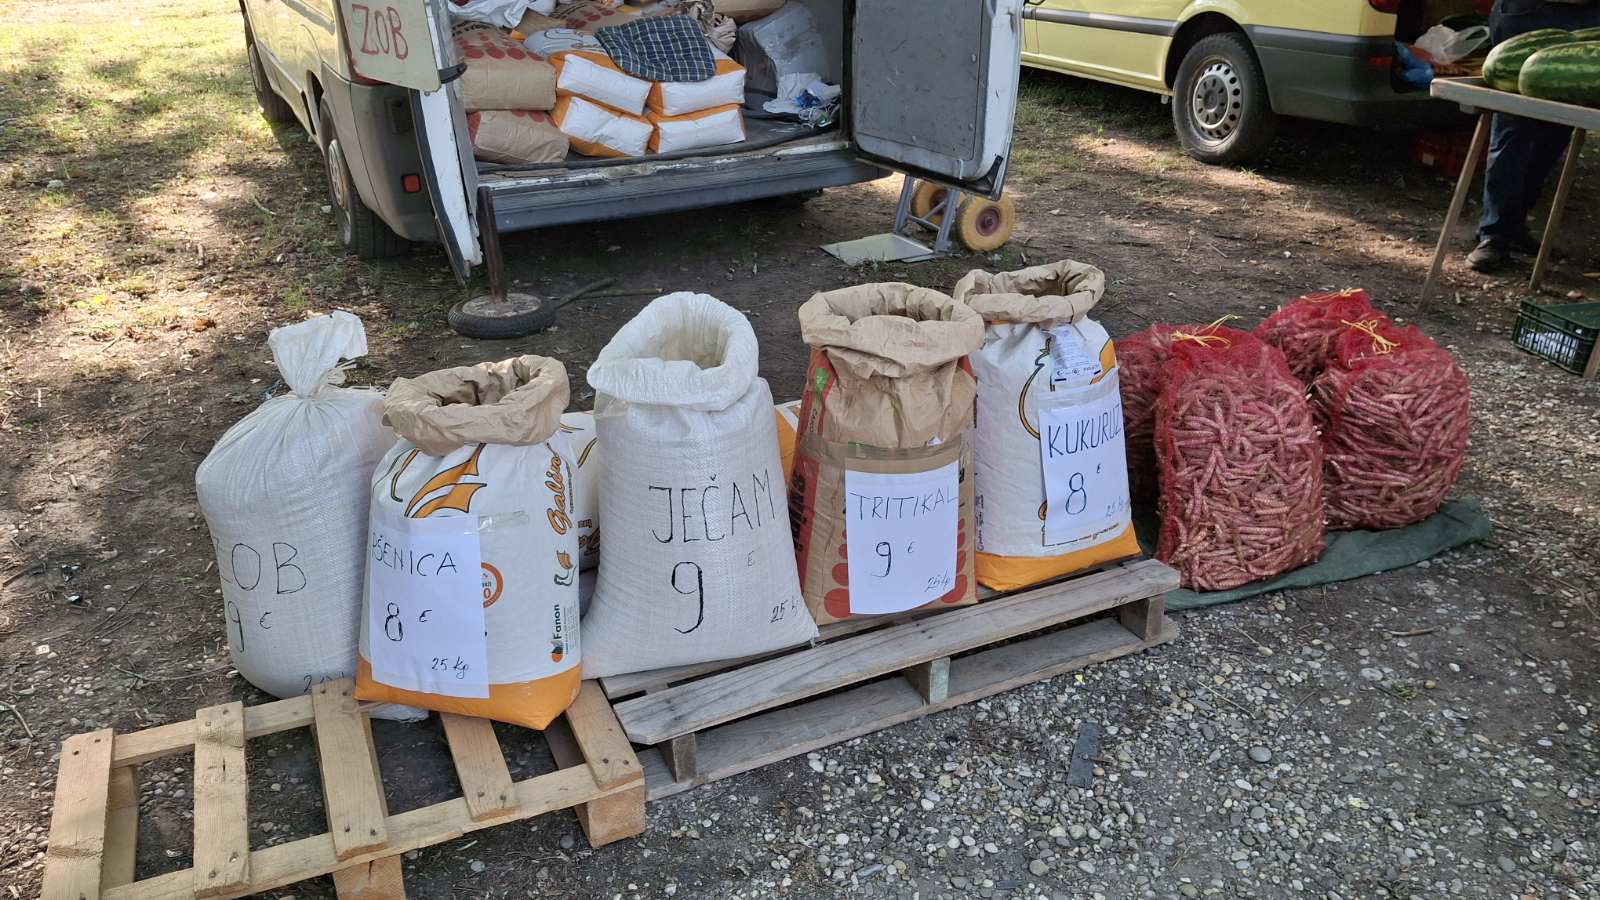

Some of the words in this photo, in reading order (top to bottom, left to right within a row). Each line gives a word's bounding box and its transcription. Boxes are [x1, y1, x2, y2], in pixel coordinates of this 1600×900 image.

[352, 4, 408, 59] ZOB
[1048, 404, 1121, 458] KUKURUZ
[649, 469, 775, 543] JEČAM
[849, 487, 958, 520] TRITIKAL
[1065, 472, 1087, 515] 8
[871, 541, 891, 577] 9
[671, 561, 704, 634] 9
[228, 601, 244, 653] 9
[260, 611, 272, 629] €
[385, 602, 403, 641] 8
[419, 609, 432, 622] €
[553, 604, 562, 639] Fanon
[431, 656, 448, 671] 25
